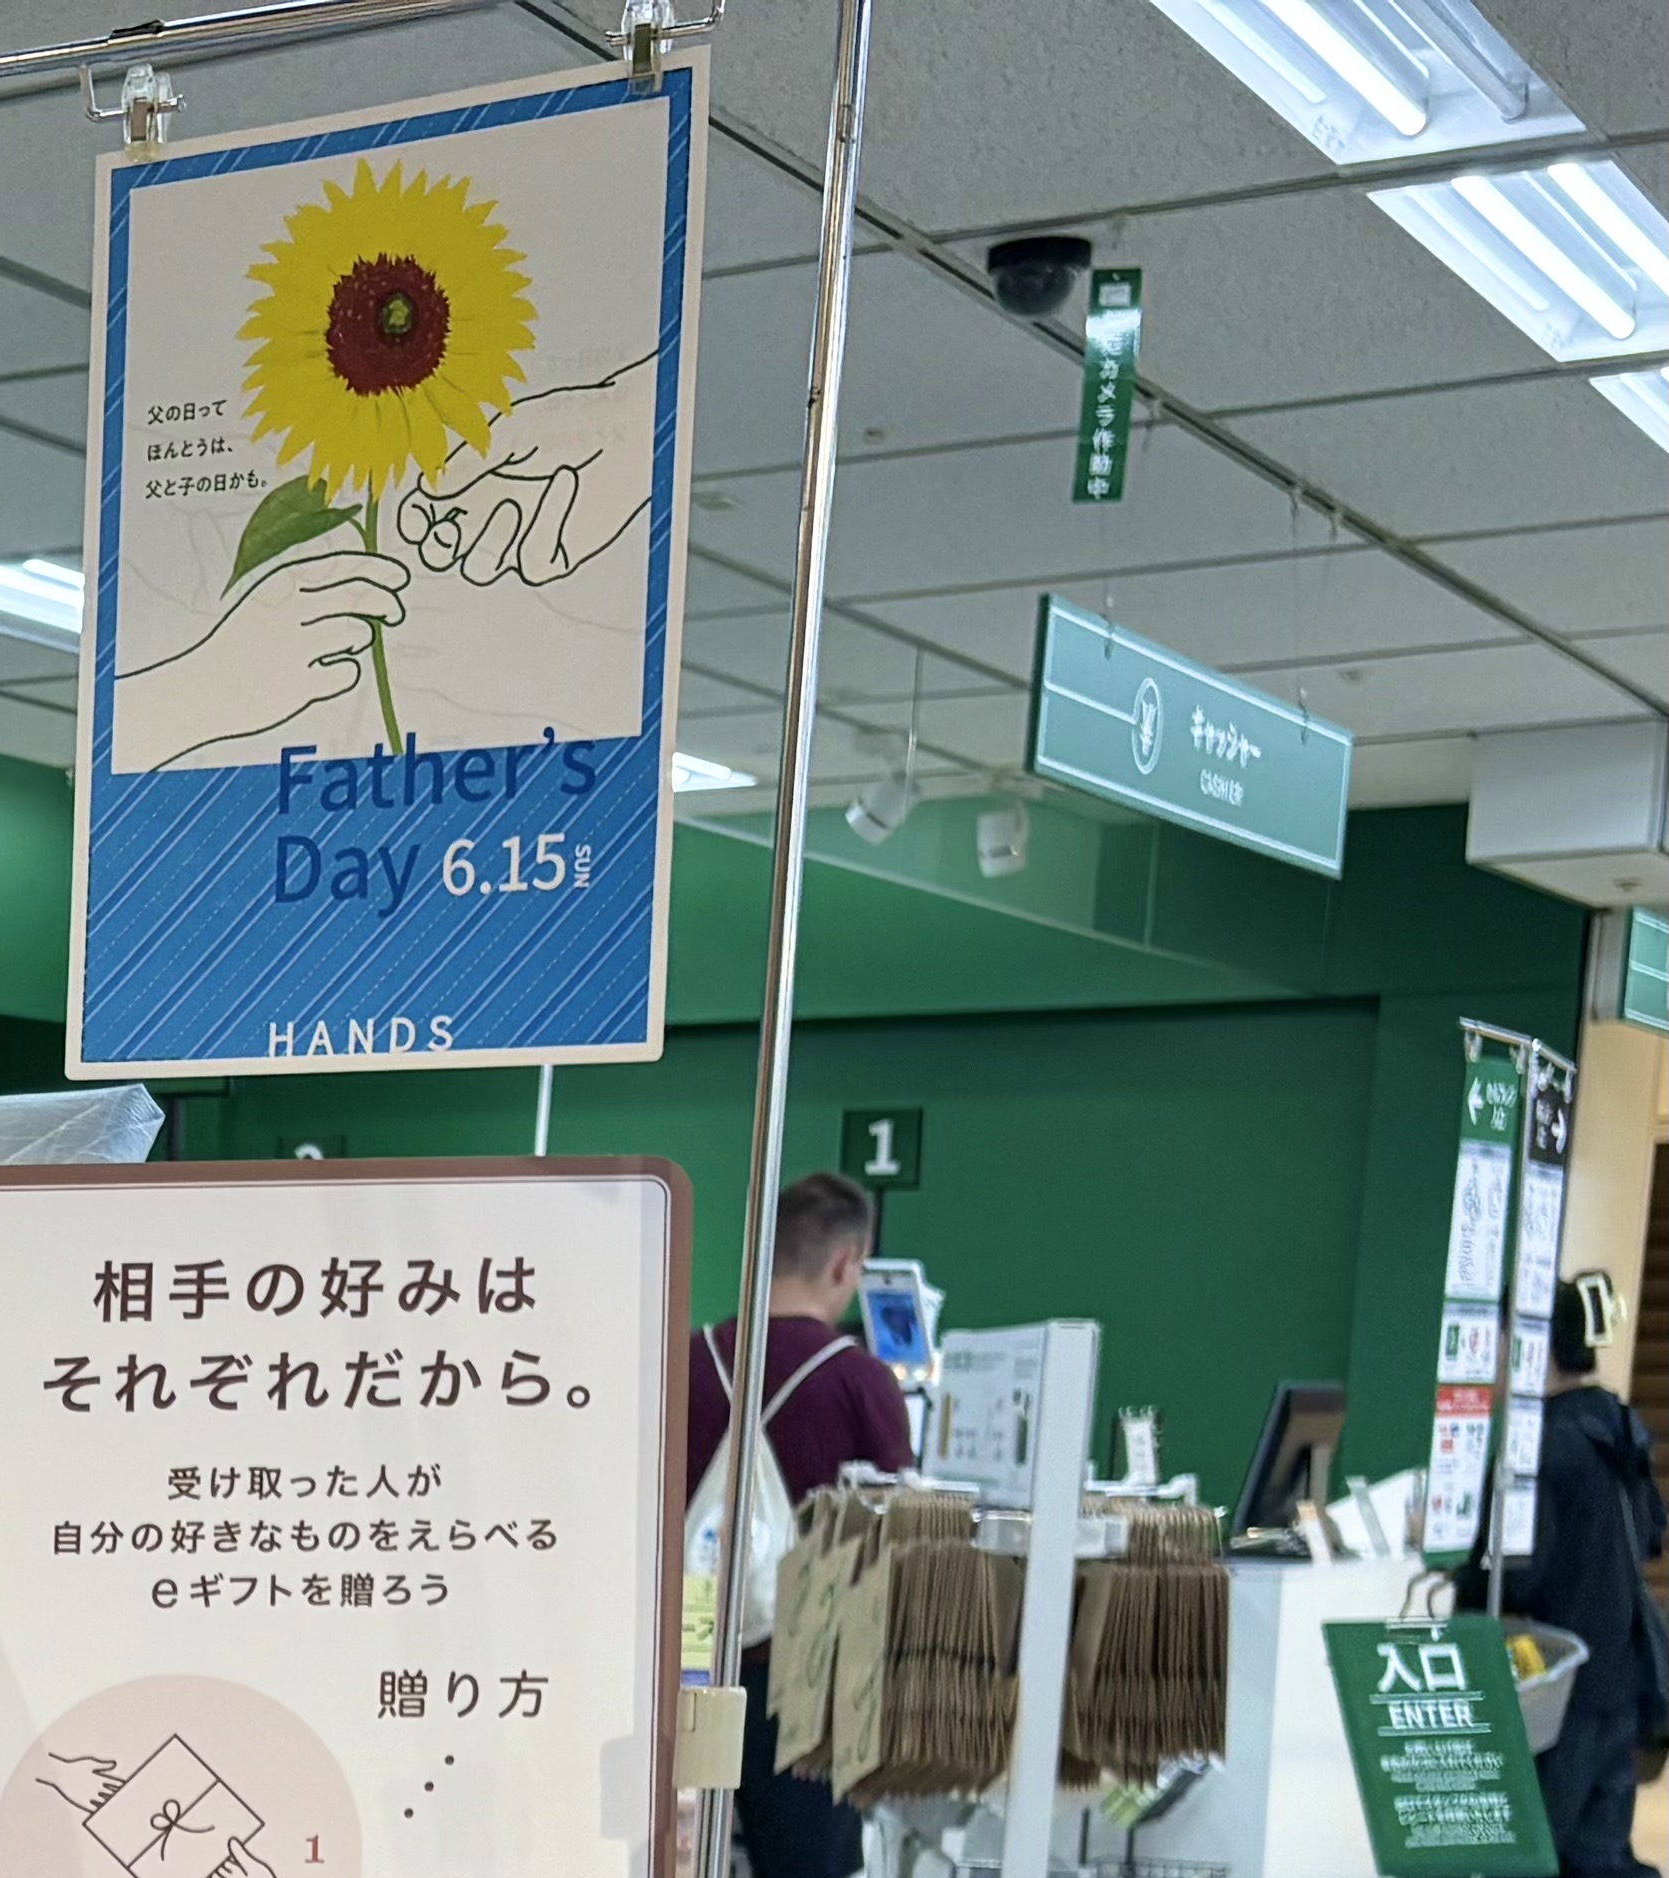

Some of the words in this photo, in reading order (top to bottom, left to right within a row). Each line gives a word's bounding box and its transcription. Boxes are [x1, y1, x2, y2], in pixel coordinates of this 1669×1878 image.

[147, 400, 228, 426] 父の日って
[147, 438, 235, 463] ほんとうは、
[145, 471, 269, 499] 父と子の日かも。
[277, 727, 598, 815] Father's
[273, 834, 422, 918] Day
[441, 833, 567, 896] 6.15
[574, 843, 591, 889] SUN
[268, 1015, 458, 1059] HANDS
[865, 1119, 902, 1176] 1
[92, 1256, 537, 1323] 相手の好みは
[42, 1348, 592, 1413] それぞれだから。
[166, 1463, 442, 1501] 受け取った人が
[53, 1518, 560, 1556] 自分の好きなものをえらべる
[151, 1572, 450, 1610] eギフトを贈ろう
[1377, 1642, 1466, 1692] 入口
[377, 1668, 550, 1721] 贈り方
[1388, 1700, 1474, 1730] ENTER
[303, 1835, 325, 1865] 1
